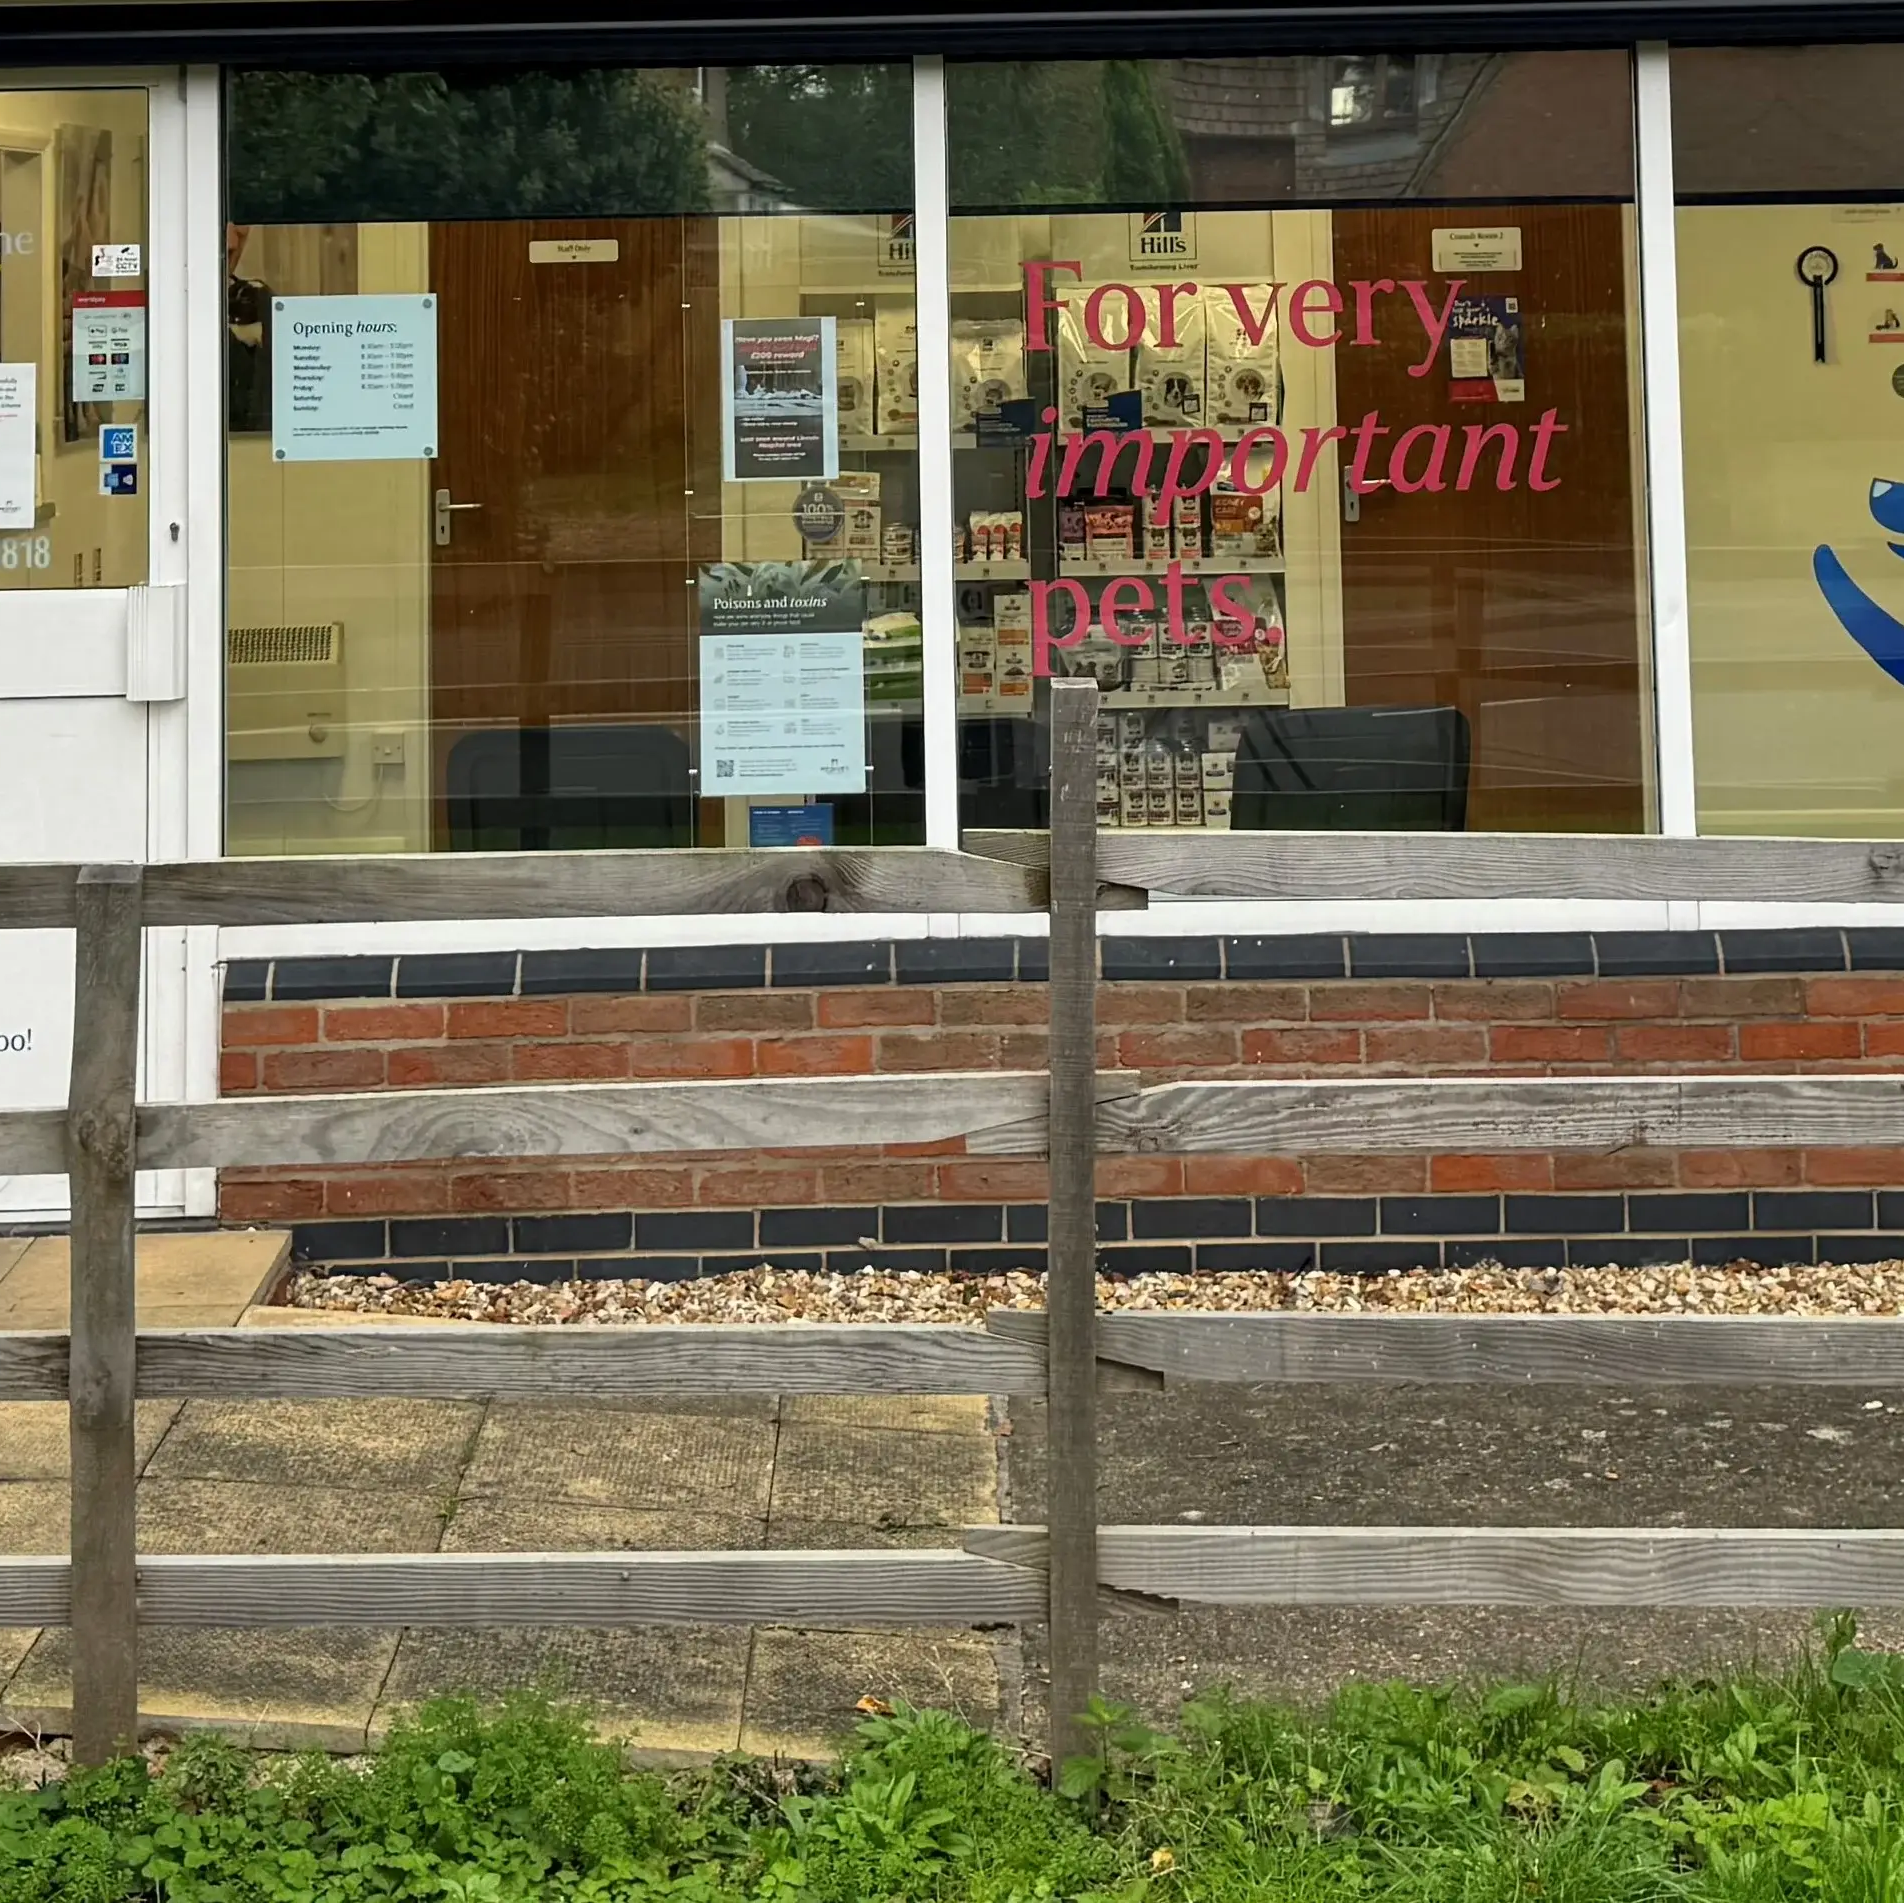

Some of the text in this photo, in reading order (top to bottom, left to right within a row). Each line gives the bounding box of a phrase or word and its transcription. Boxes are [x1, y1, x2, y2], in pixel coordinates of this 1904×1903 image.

[1140, 236, 1187, 254] Hill's
[1018, 259, 1468, 378] For very
[1453, 315, 1499, 330] sparkle
[293, 321, 353, 338] Opening
[1023, 405, 1568, 527] important
[713, 596, 828, 610] Poisons and toxins
[1023, 559, 1283, 677] pets.
